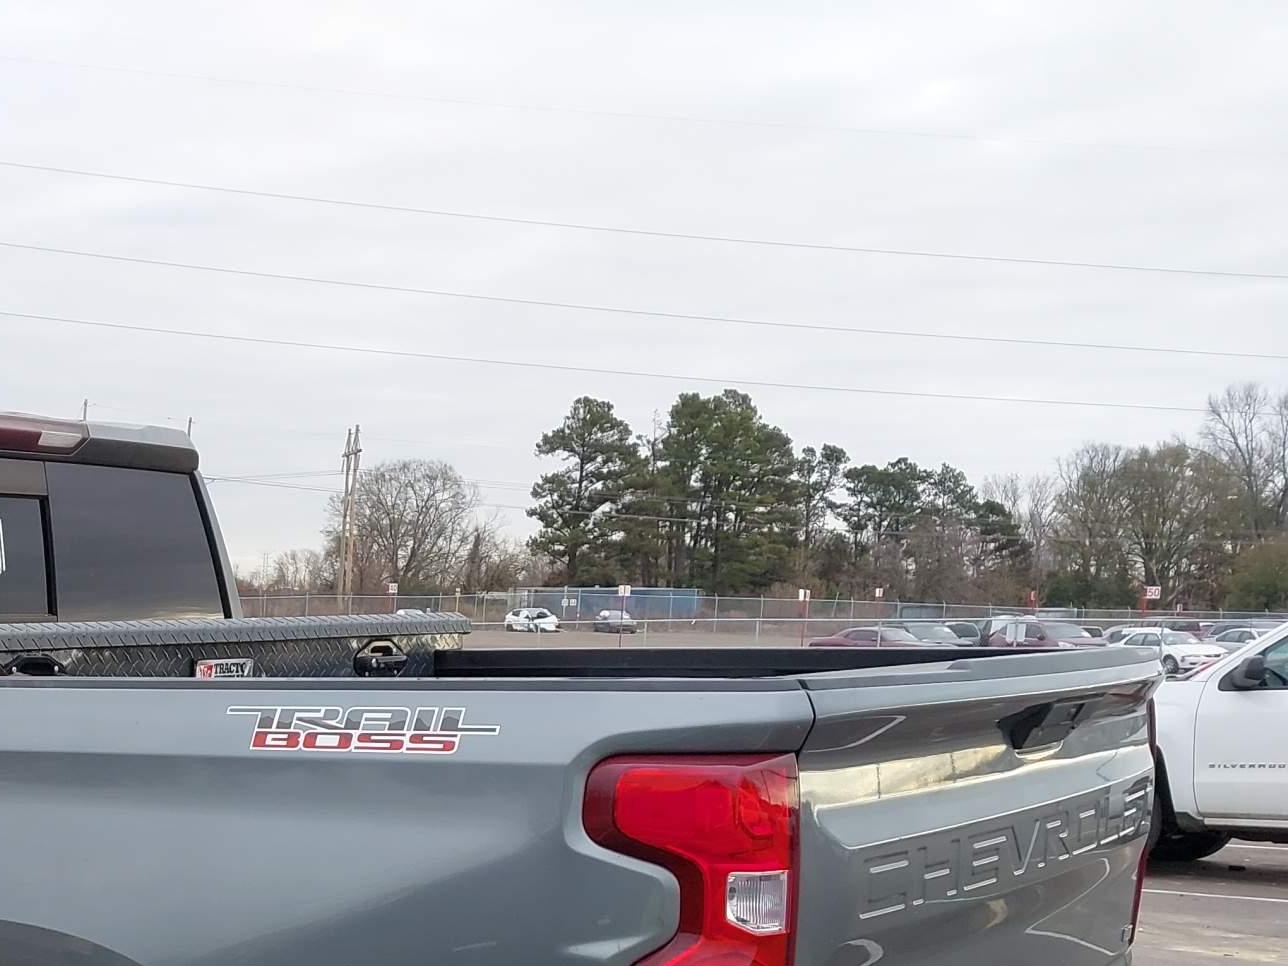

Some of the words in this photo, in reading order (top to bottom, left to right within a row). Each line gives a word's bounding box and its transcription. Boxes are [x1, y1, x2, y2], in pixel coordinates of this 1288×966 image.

[1146, 587, 1160, 597] 50
[226, 706, 501, 735] TRAIL
[250, 730, 462, 754] BOSS
